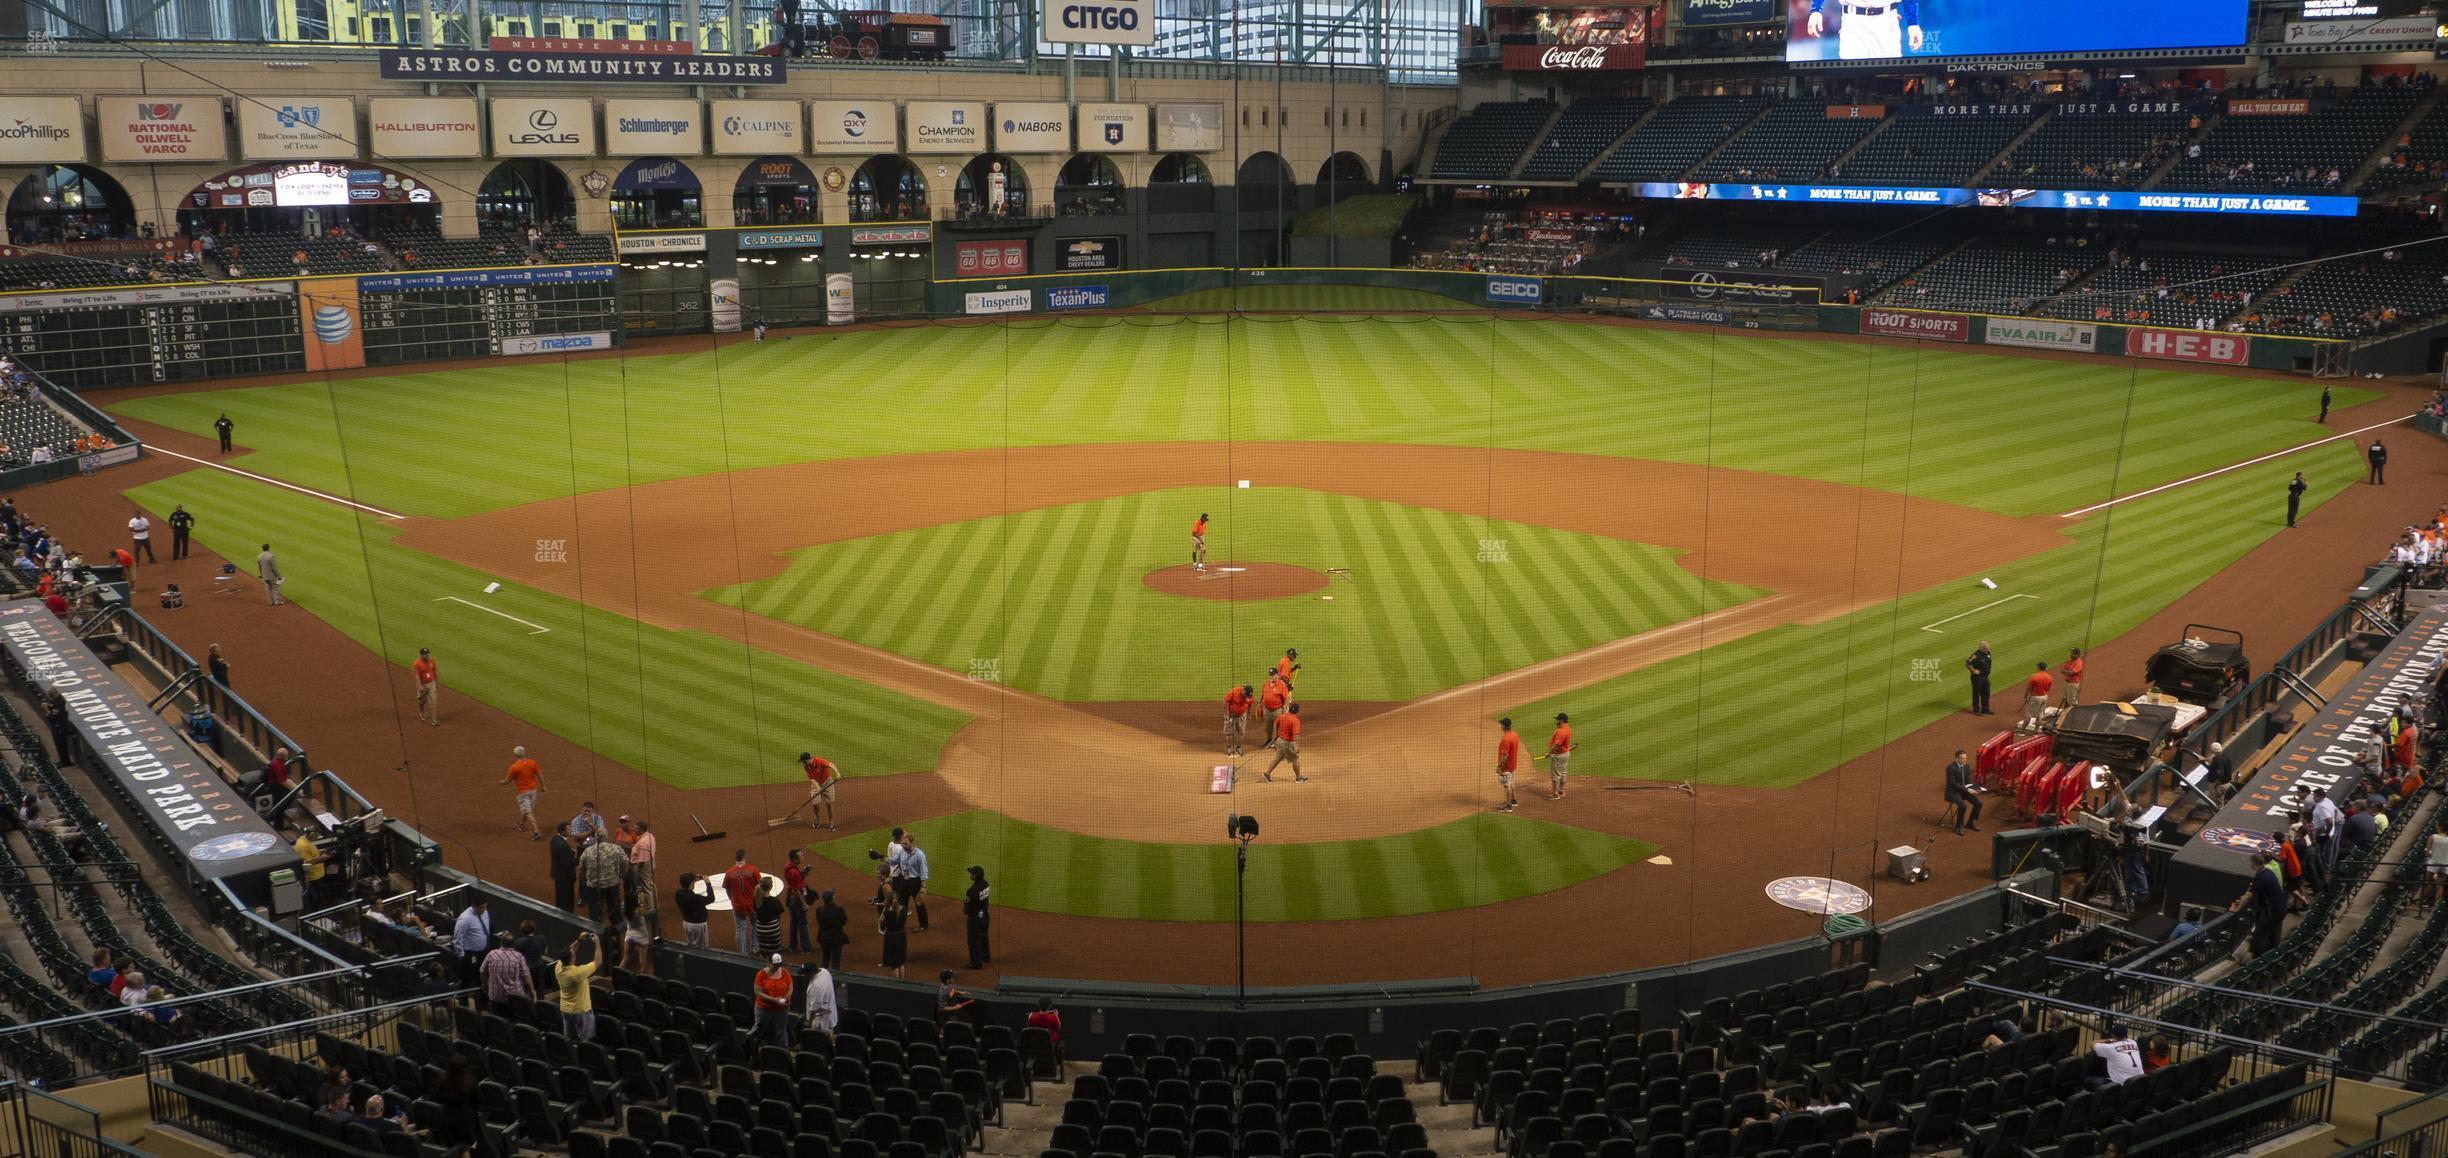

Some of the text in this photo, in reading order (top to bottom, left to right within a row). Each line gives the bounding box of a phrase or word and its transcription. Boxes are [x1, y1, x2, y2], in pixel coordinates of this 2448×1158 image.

[1063, 4, 1138, 31] CITGO
[2368, 26, 2432, 35] CREDIT UNION
[512, 41, 674, 53] MINUTE MAID
[1541, 46, 1606, 69] Coca-Cola
[508, 58, 662, 76] COMMUNITY
[674, 60, 773, 77] LEADERS
[1946, 62, 2045, 73] DAKTRONICS
[1934, 105, 1979, 115] MORE
[1989, 104, 2031, 114] THAN
[2059, 104, 2097, 115] JUST
[2108, 103, 2116, 113] A
[2238, 103, 2306, 112] ALL YOU CAN EAT
[128, 123, 196, 133] NATIONAL
[375, 122, 476, 132] HALLIBURTON
[619, 118, 689, 136] Schlumberger
[742, 121, 793, 132] CALPINE
[843, 119, 868, 127] OXY
[1017, 122, 1062, 132] NABORS
[135, 134, 192, 144] OILWELL
[257, 132, 342, 141] BlueCross BlueShield
[508, 133, 580, 145] LEXUS
[143, 145, 187, 154] VARCO
[284, 142, 318, 150] of Texas
[275, 160, 350, 180] Landry's
[760, 163, 793, 175] ROOT
[1810, 189, 1842, 199] MORE
[1843, 190, 1871, 200] THAN
[1872, 190, 1894, 202] JUST
[1895, 191, 1903, 200] A
[2139, 196, 2180, 208] MORE
[2182, 197, 2219, 209] THAN
[2220, 198, 2249, 211] JUST
[2249, 199, 2260, 209] A
[744, 233, 817, 246] C&D SCRAP METAL
[1528, 230, 1572, 241] Budweiser
[620, 236, 702, 249] HOUSTON CHRONICLE
[962, 257, 974, 266] 66
[985, 257, 997, 265] 66
[1007, 256, 1019, 264] 66
[1068, 255, 1091, 263] HOUSTON
[1489, 281, 1540, 297] GEICO
[62, 297, 82, 305] Bring
[143, 292, 163, 300] bmc
[981, 295, 1029, 309] Insperity
[1049, 291, 1105, 307] TexanPlus
[24, 299, 43, 307] bmc
[680, 301, 699, 311] 362
[487, 291, 498, 352] AMERICAN
[1668, 309, 1723, 322] PLATINUM POOLS
[1869, 311, 1958, 332] ROOT SPORTS
[1990, 327, 2057, 341] EVA AIR
[149, 310, 162, 378] NATIONAL
[541, 336, 592, 350] mazda
[2142, 333, 2236, 360] H-E-B
[2, 621, 68, 671] WELCOME
[46, 670, 83, 687] TO
[62, 688, 131, 740] MINUTE
[2240, 746, 2317, 812] WELCOME
[2313, 723, 2338, 737] TO
[2336, 675, 2386, 716] MINUTE
[2380, 645, 2416, 669] MAID
[2317, 745, 2357, 768] OF
[2337, 715, 2375, 744] THE
[107, 693, 175, 754] HOUSTON
[173, 762, 243, 822] ASTROS
[108, 740, 170, 781] MAID
[147, 783, 216, 831] PARK
[2128, 1052, 2137, 1068] 1
